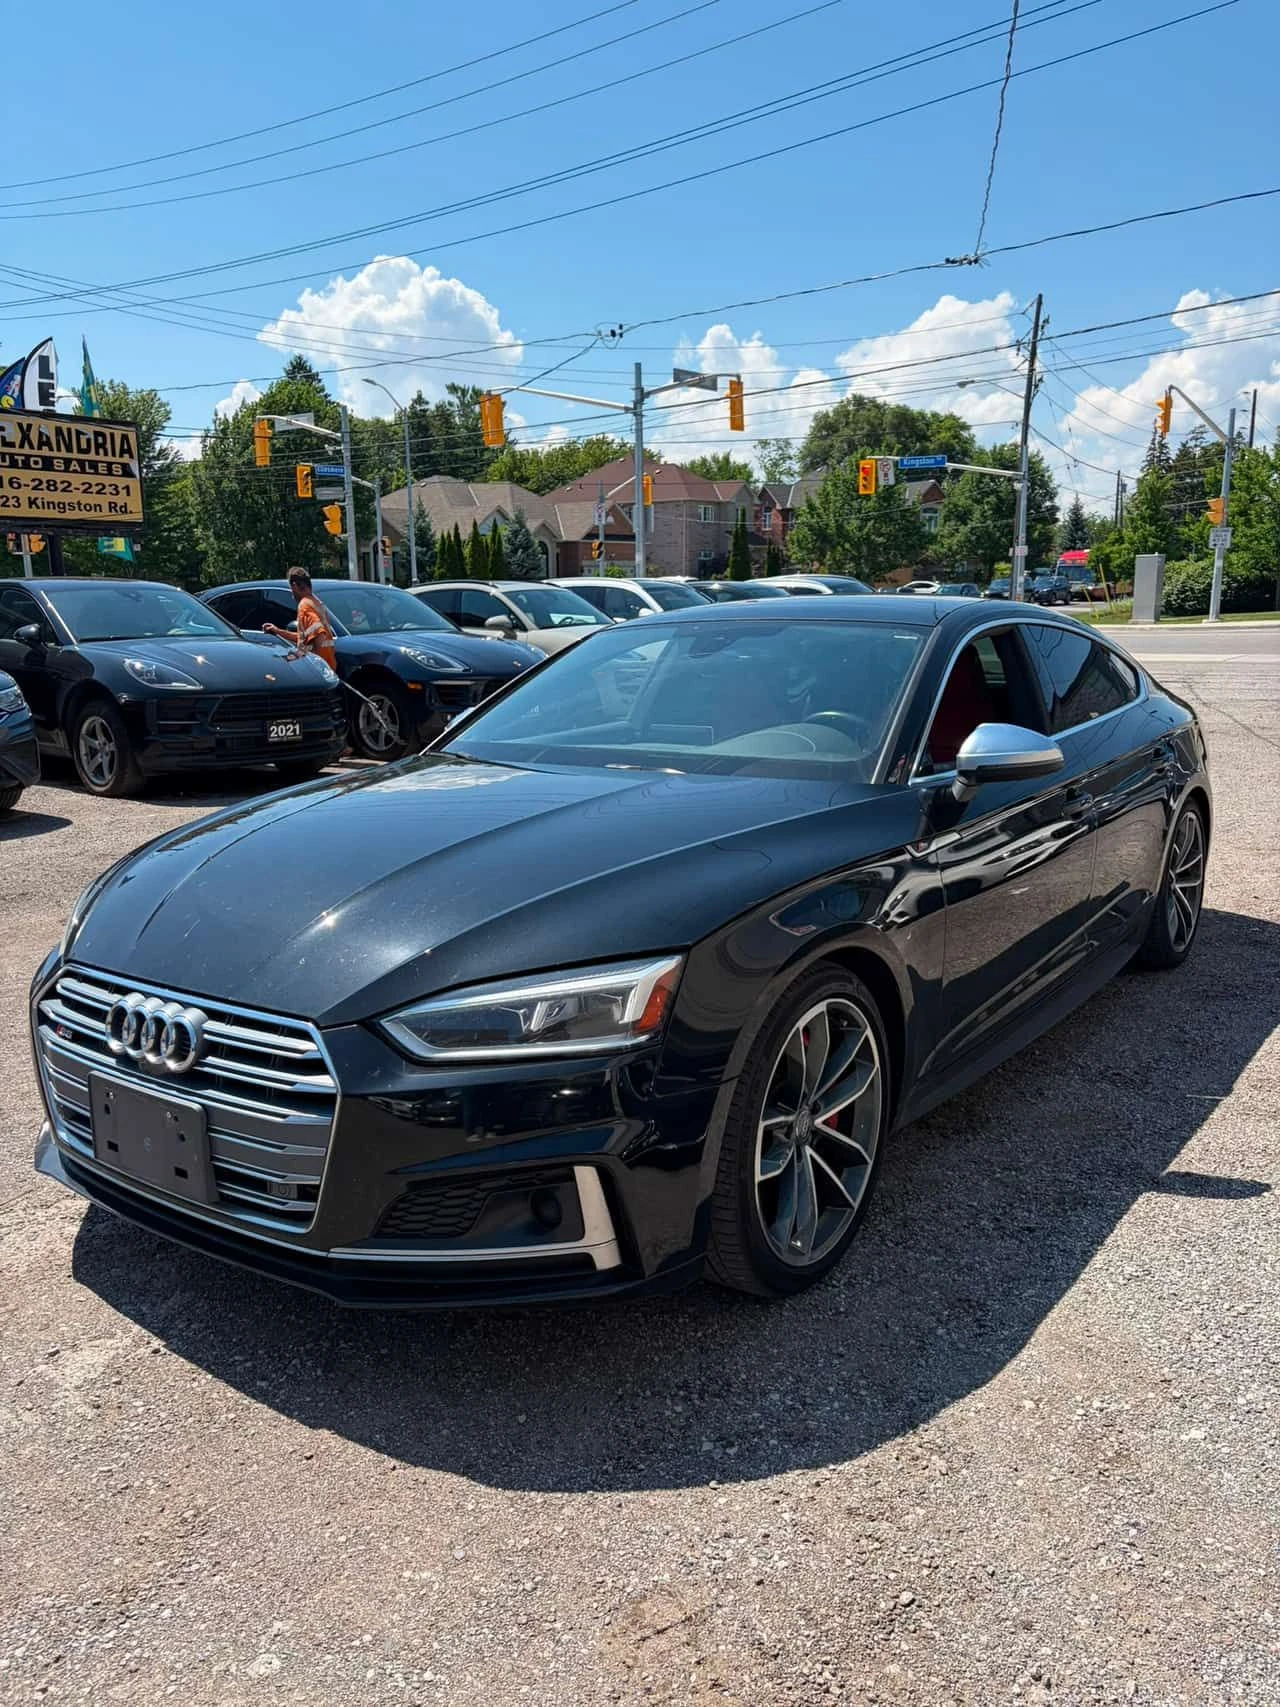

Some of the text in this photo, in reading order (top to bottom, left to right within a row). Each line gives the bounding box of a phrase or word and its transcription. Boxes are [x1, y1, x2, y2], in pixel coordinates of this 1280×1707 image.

[53, 459, 122, 475] SALES
[903, 457, 935, 467] Kingston
[27, 496, 103, 513] Kingston
[108, 501, 133, 514] Rd.
[270, 723, 300, 737] 2021
